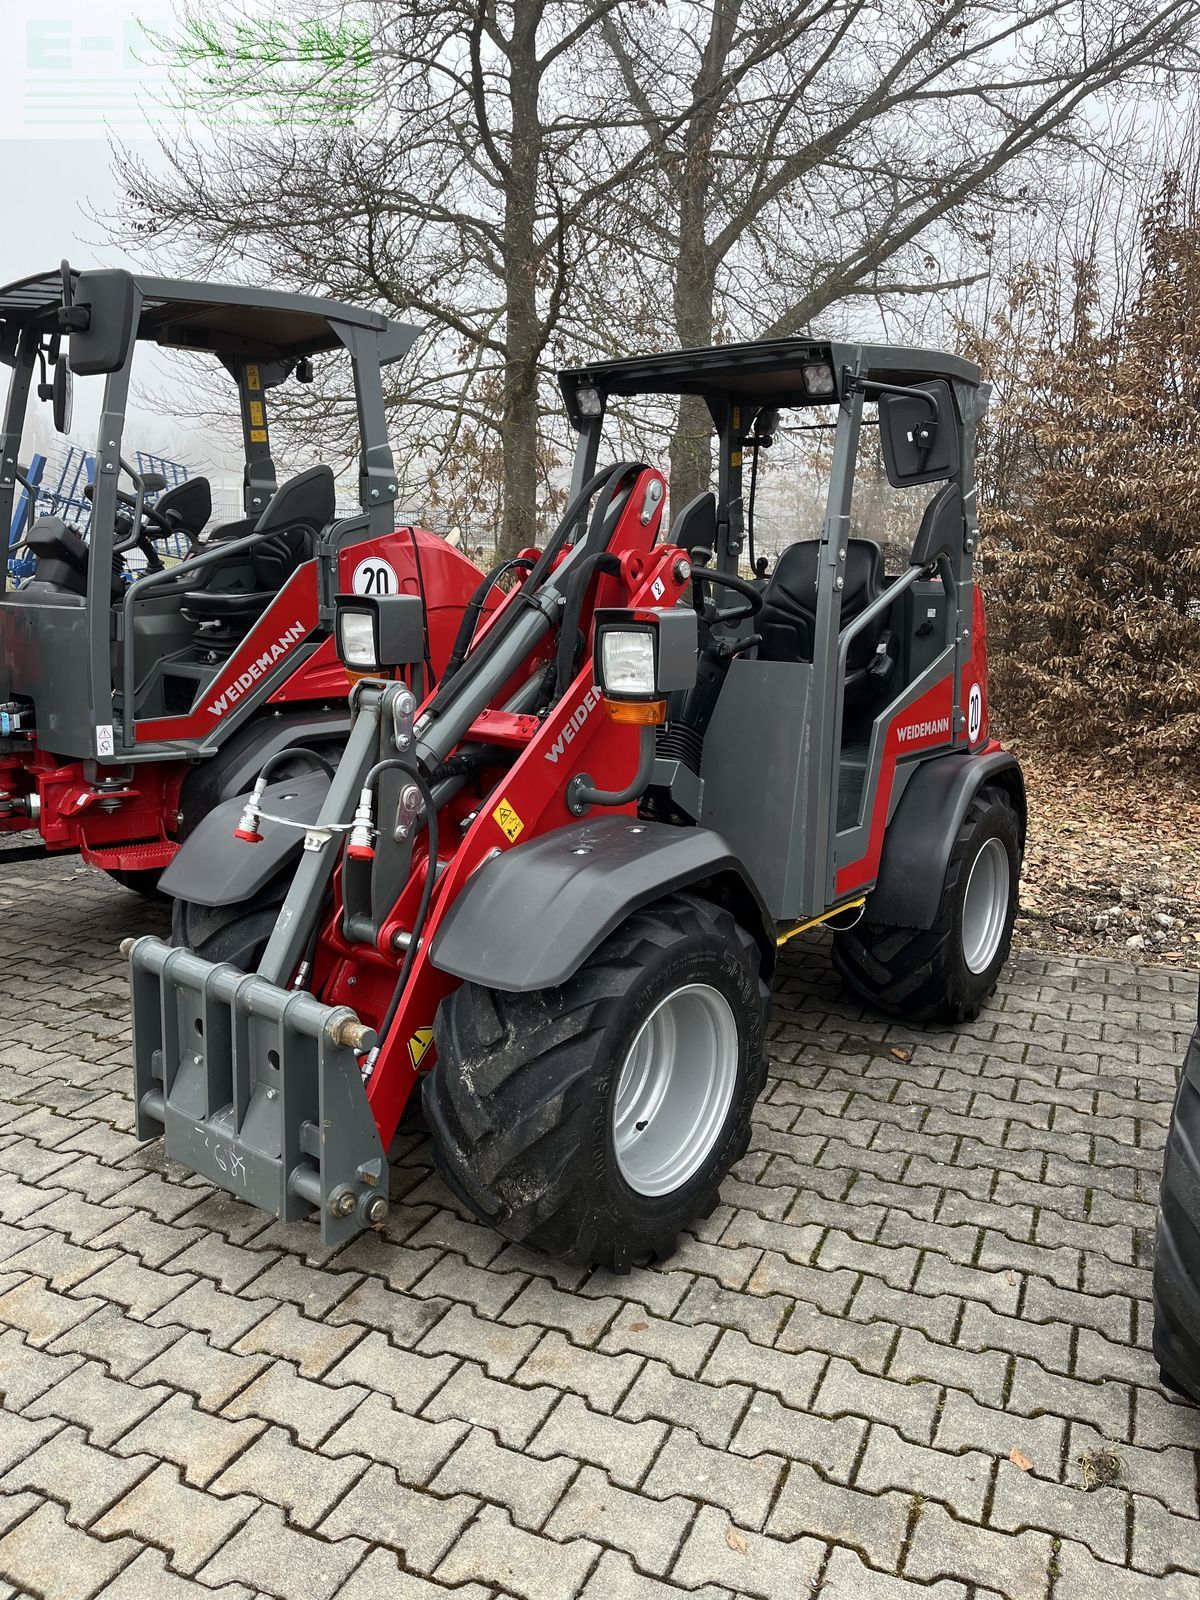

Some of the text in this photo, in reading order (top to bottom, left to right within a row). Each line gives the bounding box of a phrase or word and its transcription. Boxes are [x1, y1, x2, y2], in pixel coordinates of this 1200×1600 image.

[363, 567, 389, 594] 20
[207, 620, 306, 716] WEIDEMANN
[970, 694, 979, 732] 20
[897, 718, 949, 742] WEIDEMANN
